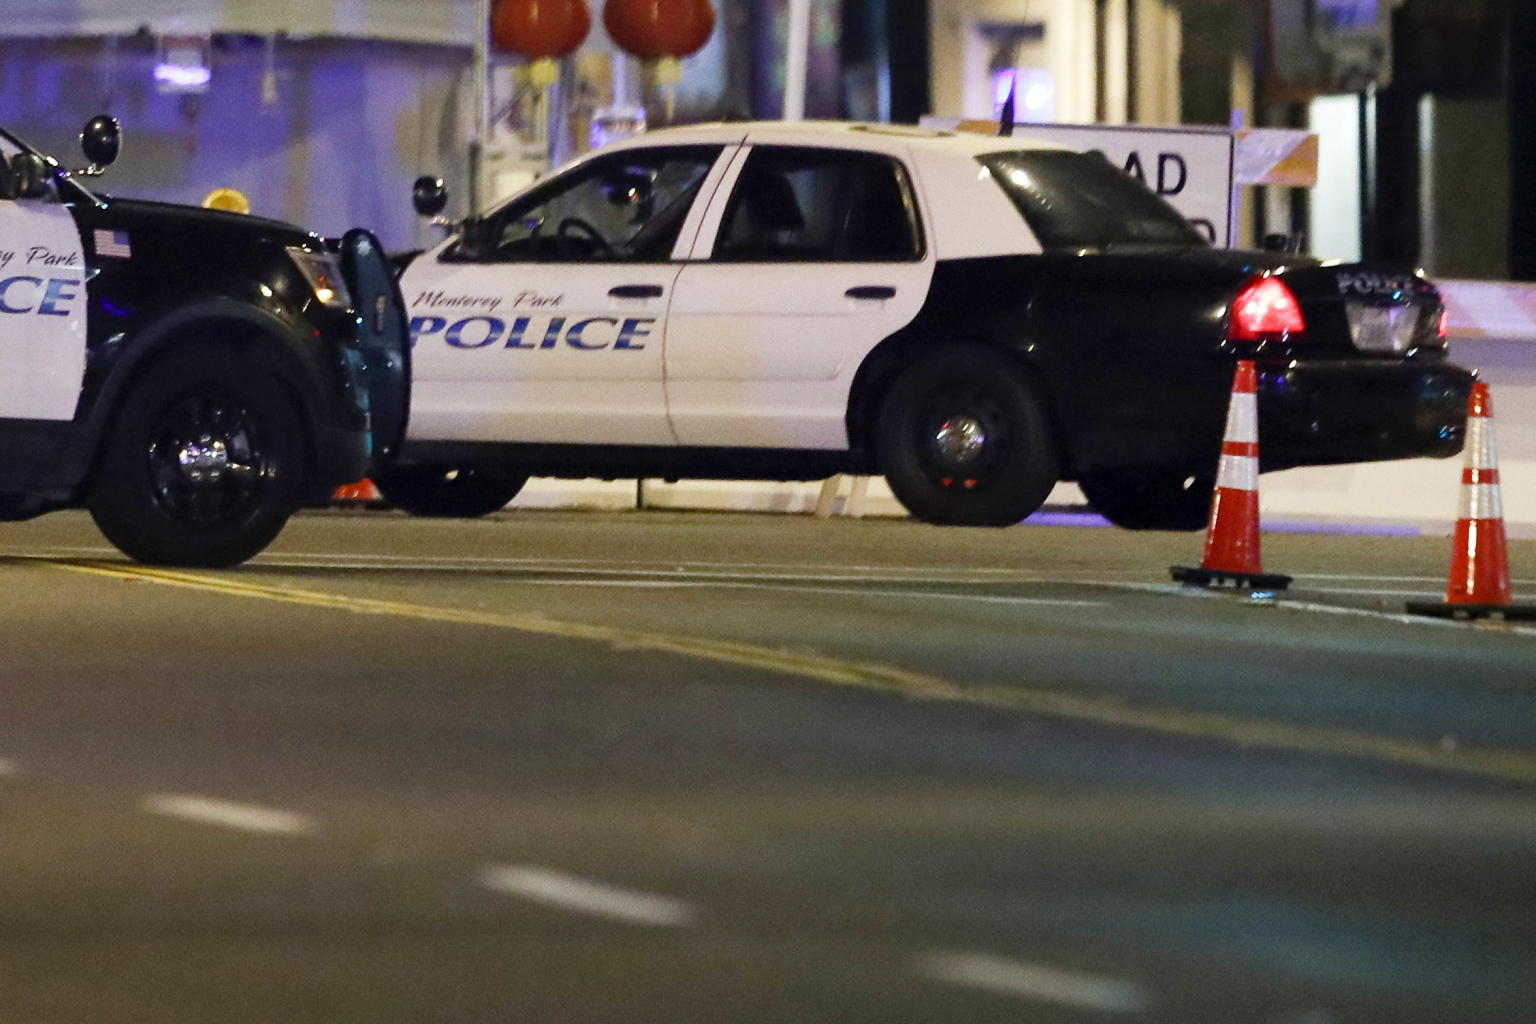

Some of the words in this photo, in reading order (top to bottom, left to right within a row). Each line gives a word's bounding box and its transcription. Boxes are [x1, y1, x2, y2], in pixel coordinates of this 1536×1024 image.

[1124, 150, 1187, 196] AD
[27, 246, 80, 267] Park
[412, 290, 503, 312] Monterey
[513, 289, 565, 309] Park
[410, 316, 656, 351] POLICE
